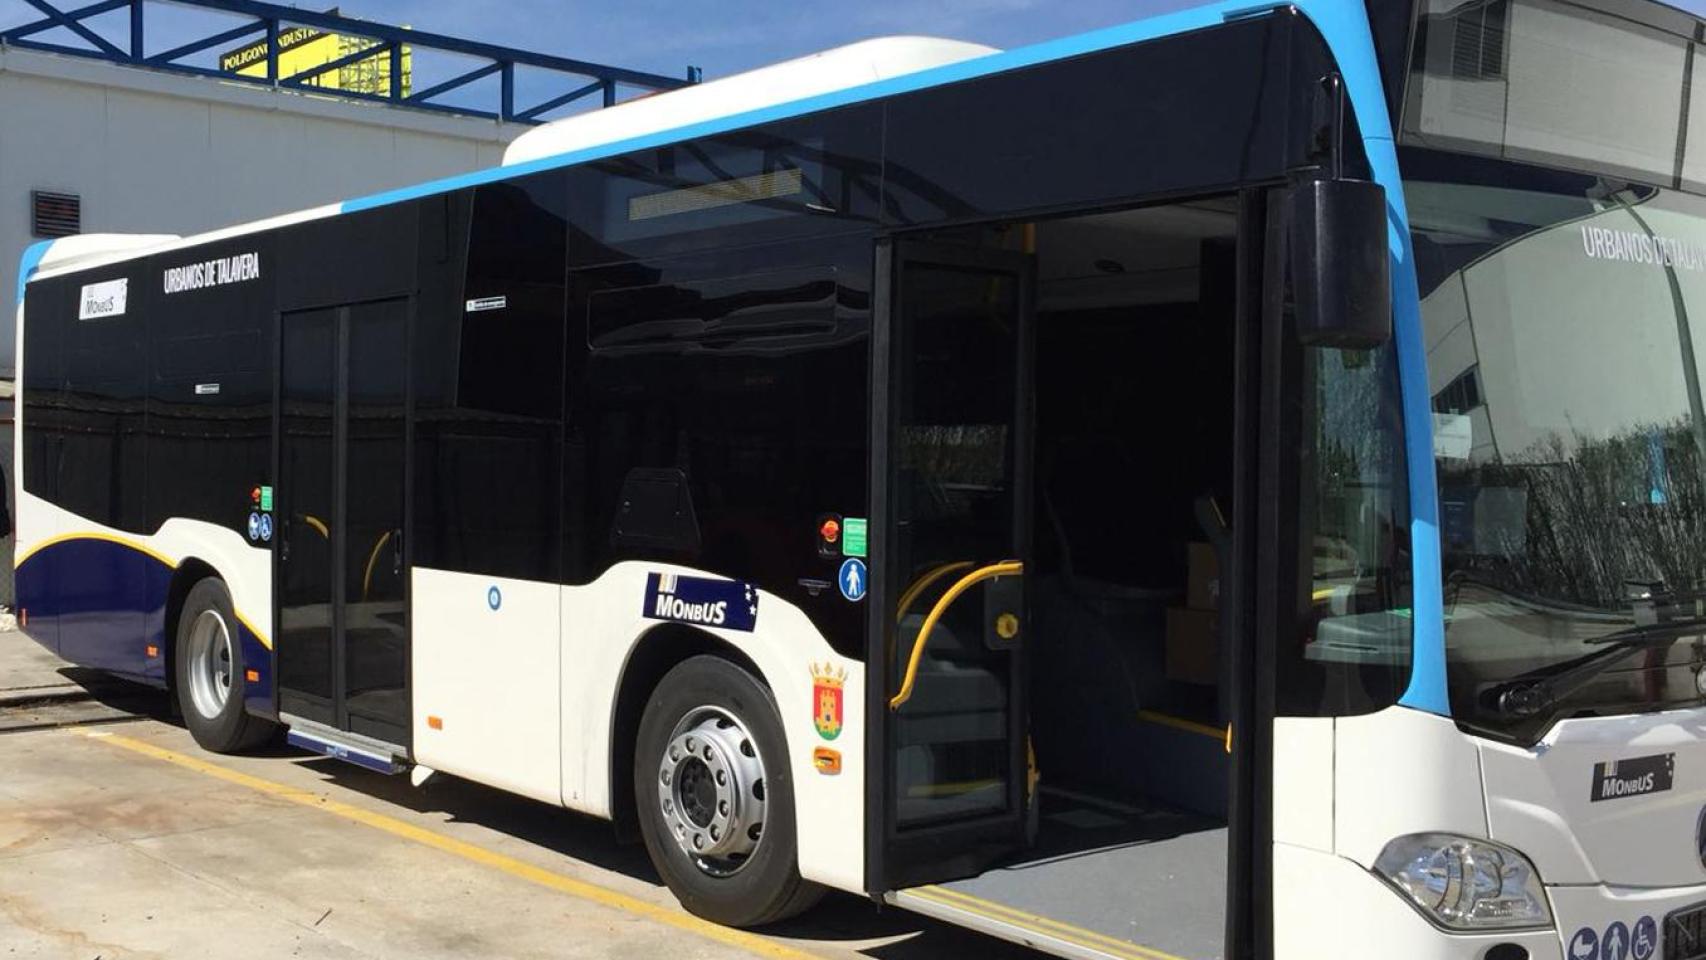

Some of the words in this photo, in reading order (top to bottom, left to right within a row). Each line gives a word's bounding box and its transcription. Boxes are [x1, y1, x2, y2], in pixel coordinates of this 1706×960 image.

[1581, 226, 1653, 264] URBANOS
[1652, 236, 1671, 266] DE
[164, 262, 204, 294] URBANOS
[204, 260, 216, 287] DE
[217, 252, 260, 284] TALAVERA
